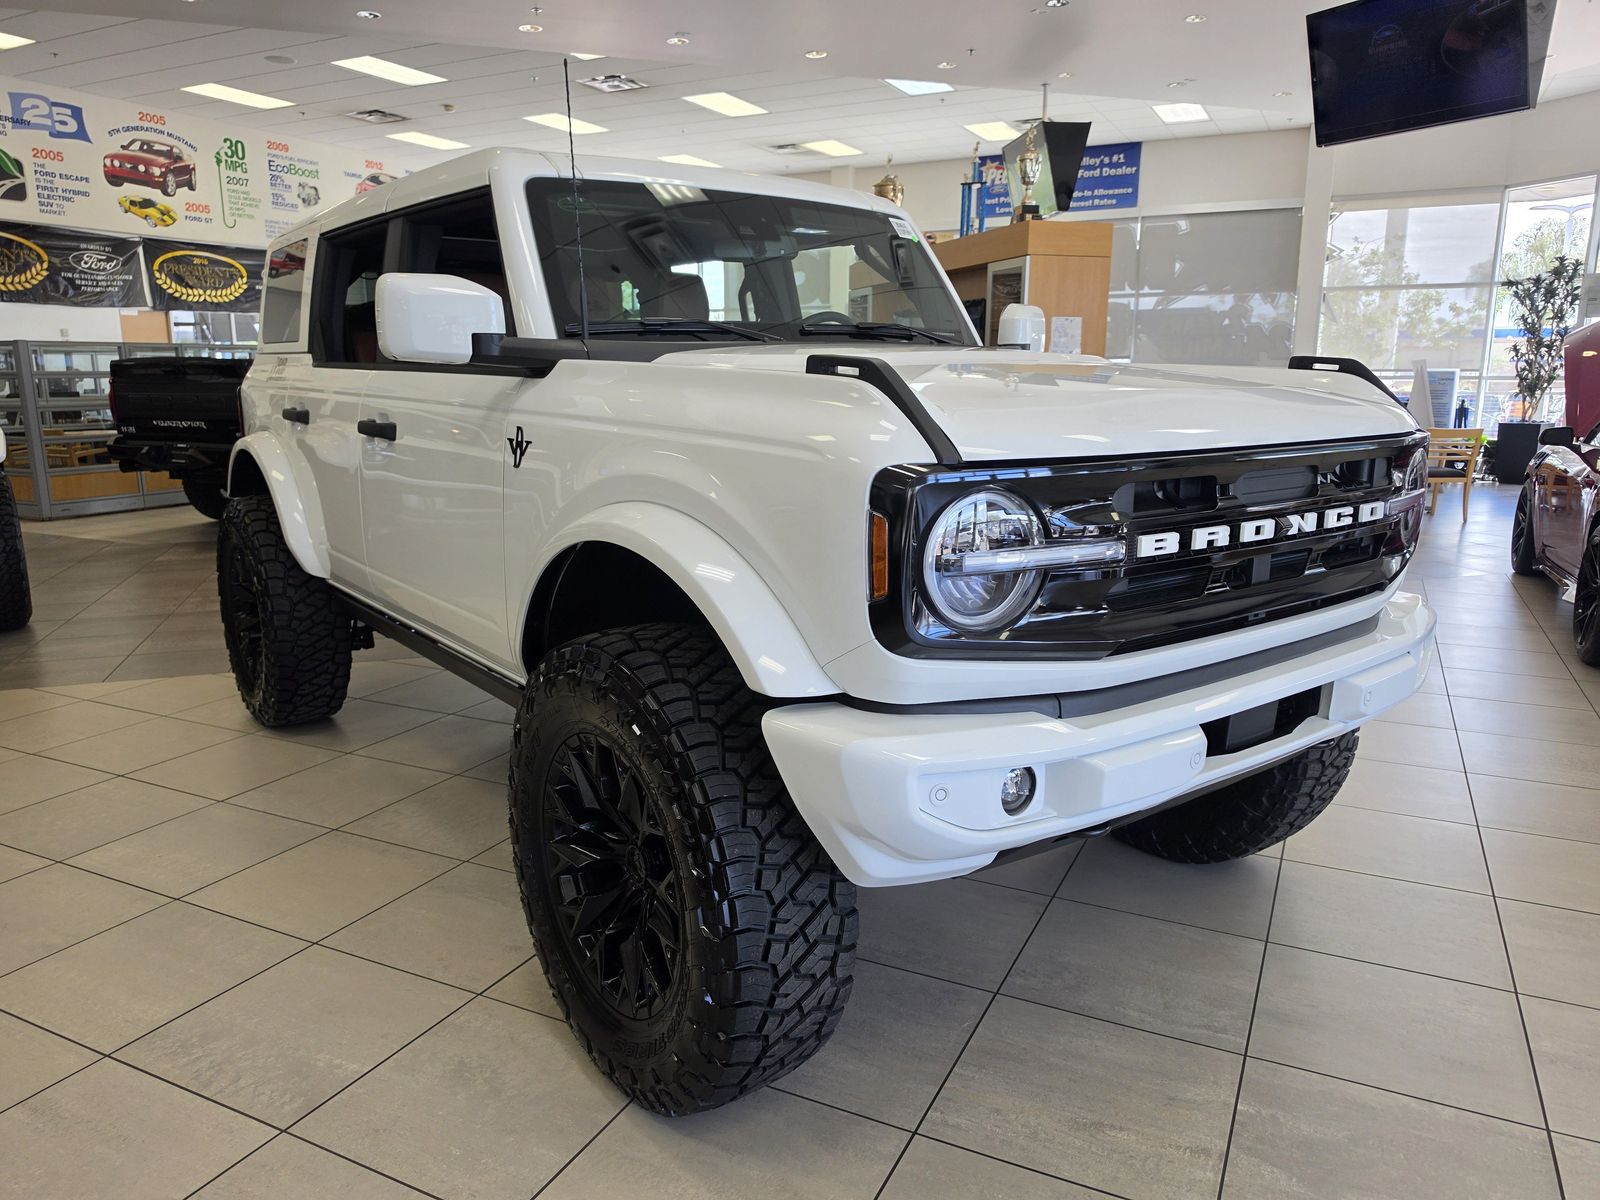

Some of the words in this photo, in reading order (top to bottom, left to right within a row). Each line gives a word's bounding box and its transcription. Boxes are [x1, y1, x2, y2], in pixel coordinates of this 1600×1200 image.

[20, 97, 79, 134] 25
[138, 111, 167, 126] 2005
[108, 127, 121, 137] 5TH
[121, 125, 166, 136] GENERATION
[166, 131, 198, 153] MUSTANG
[223, 137, 246, 161] 30
[266, 140, 289, 153] 2009
[31, 147, 64, 163] 2005
[1111, 153, 1126, 164] #1
[33, 161, 46, 170] THE
[224, 159, 248, 174] MPG
[268, 159, 320, 180] EcoBoost
[1078, 168, 1101, 178] Ford
[1102, 166, 1137, 177] Dealer
[34, 169, 57, 179] FORD
[59, 173, 90, 184] ESCAPE
[225, 175, 249, 188] 2007
[36, 184, 59, 193] FIRST
[61, 188, 90, 198] HYBRID
[37, 192, 75, 203] ELECTRIC
[1093, 187, 1133, 197] Allowance
[38, 200, 54, 208] SUV
[184, 201, 211, 215] 2005
[184, 214, 203, 223] FORD
[204, 217, 213, 225] GT
[80, 253, 117, 271] Ford
[163, 262, 240, 281] PRESIDENT'S
[1137, 501, 1385, 558] BRONCO
